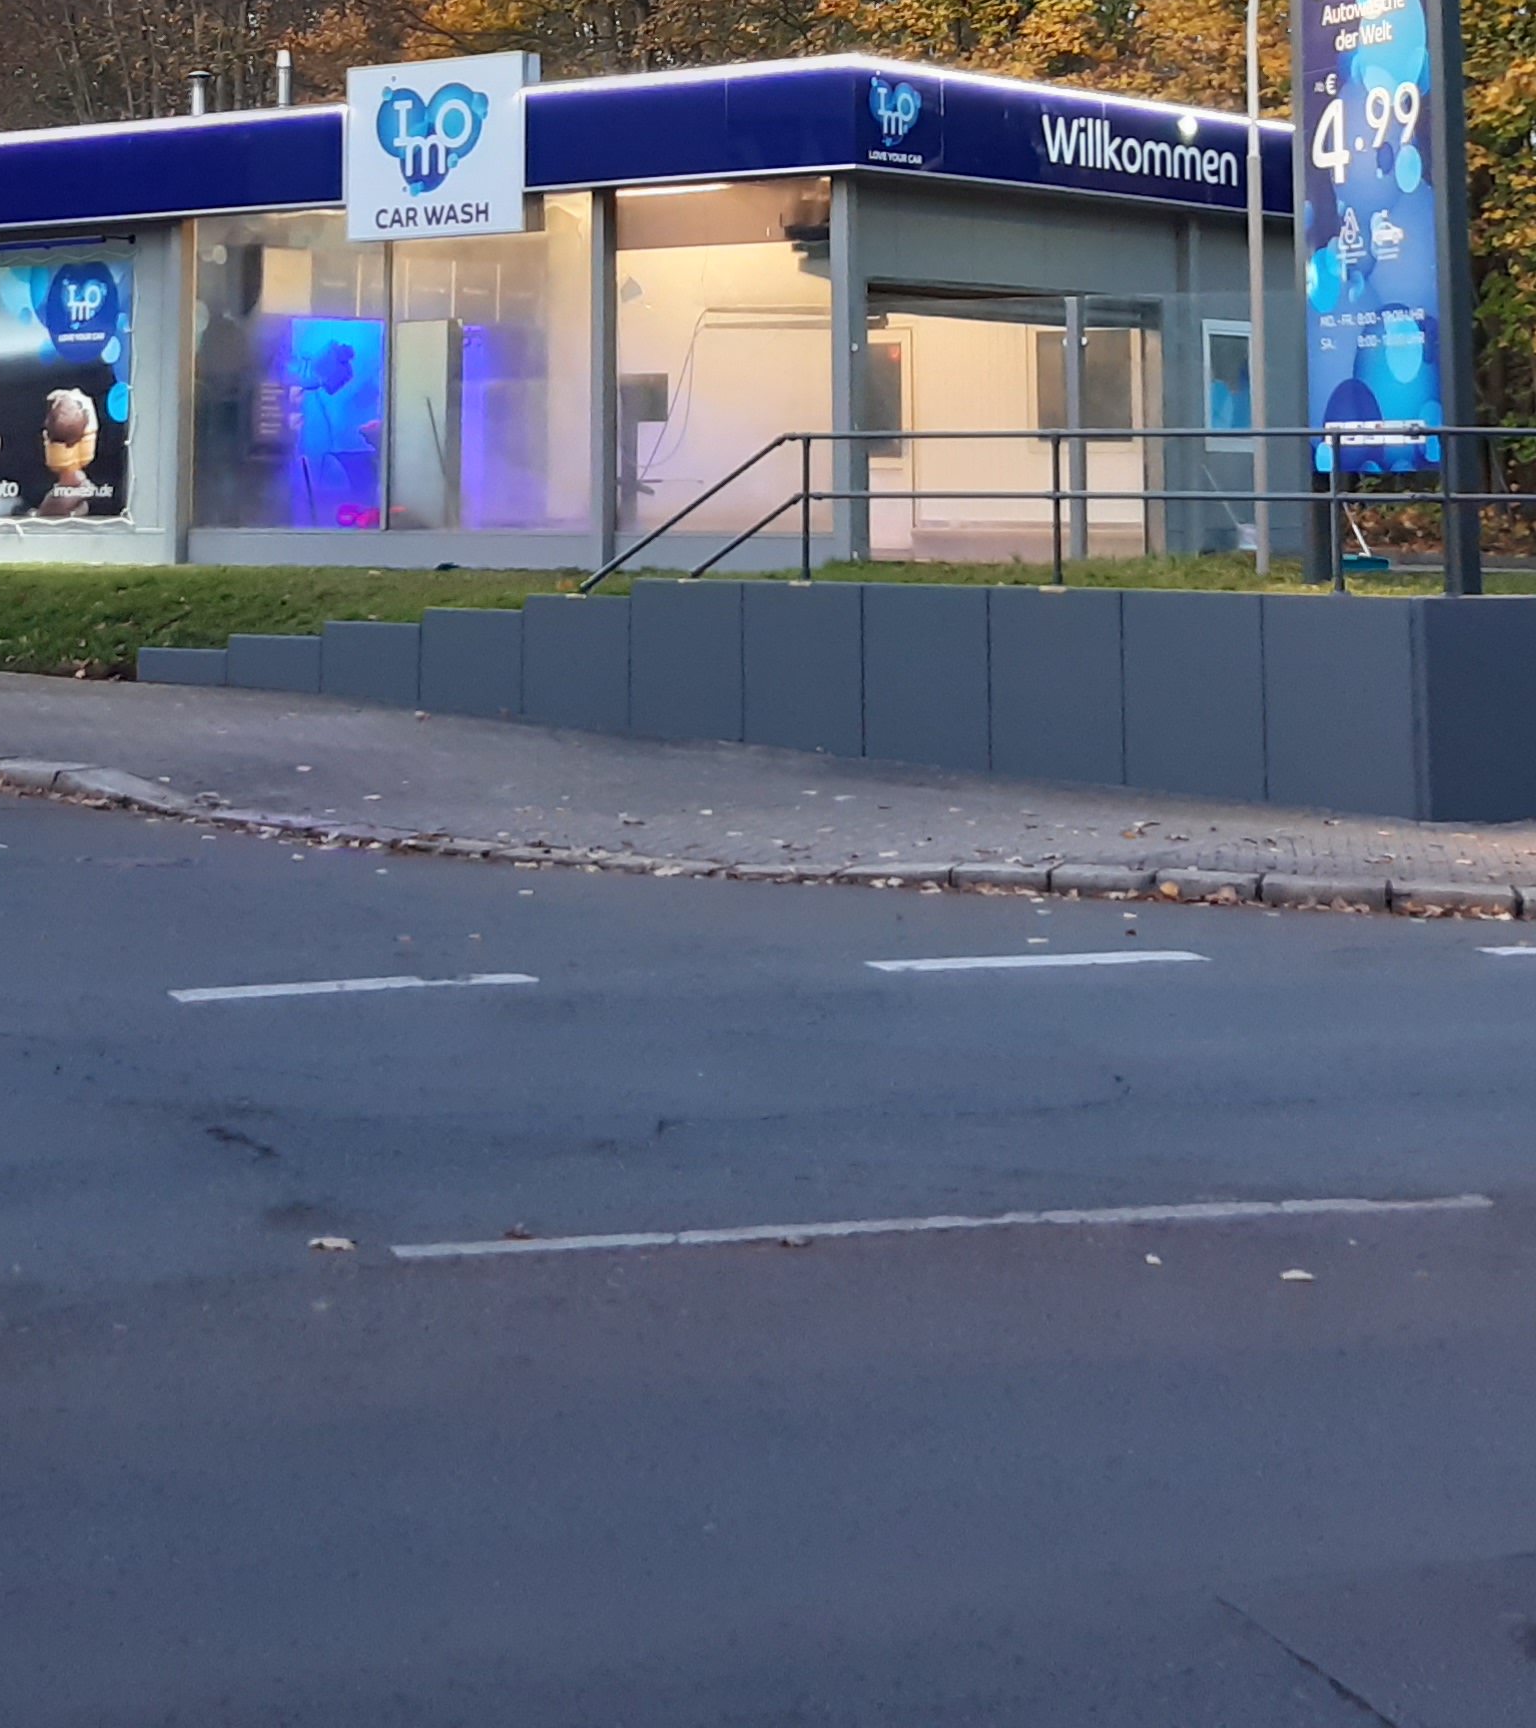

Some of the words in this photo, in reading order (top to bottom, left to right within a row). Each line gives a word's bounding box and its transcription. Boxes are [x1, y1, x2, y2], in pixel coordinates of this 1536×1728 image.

[1334, 28, 1359, 51] der
[1360, 18, 1393, 46] Welt
[1040, 113, 1239, 188] Willkommen
[1311, 81, 1421, 185] 4.99
[375, 206, 419, 230] CAR
[424, 201, 490, 227] WASH
